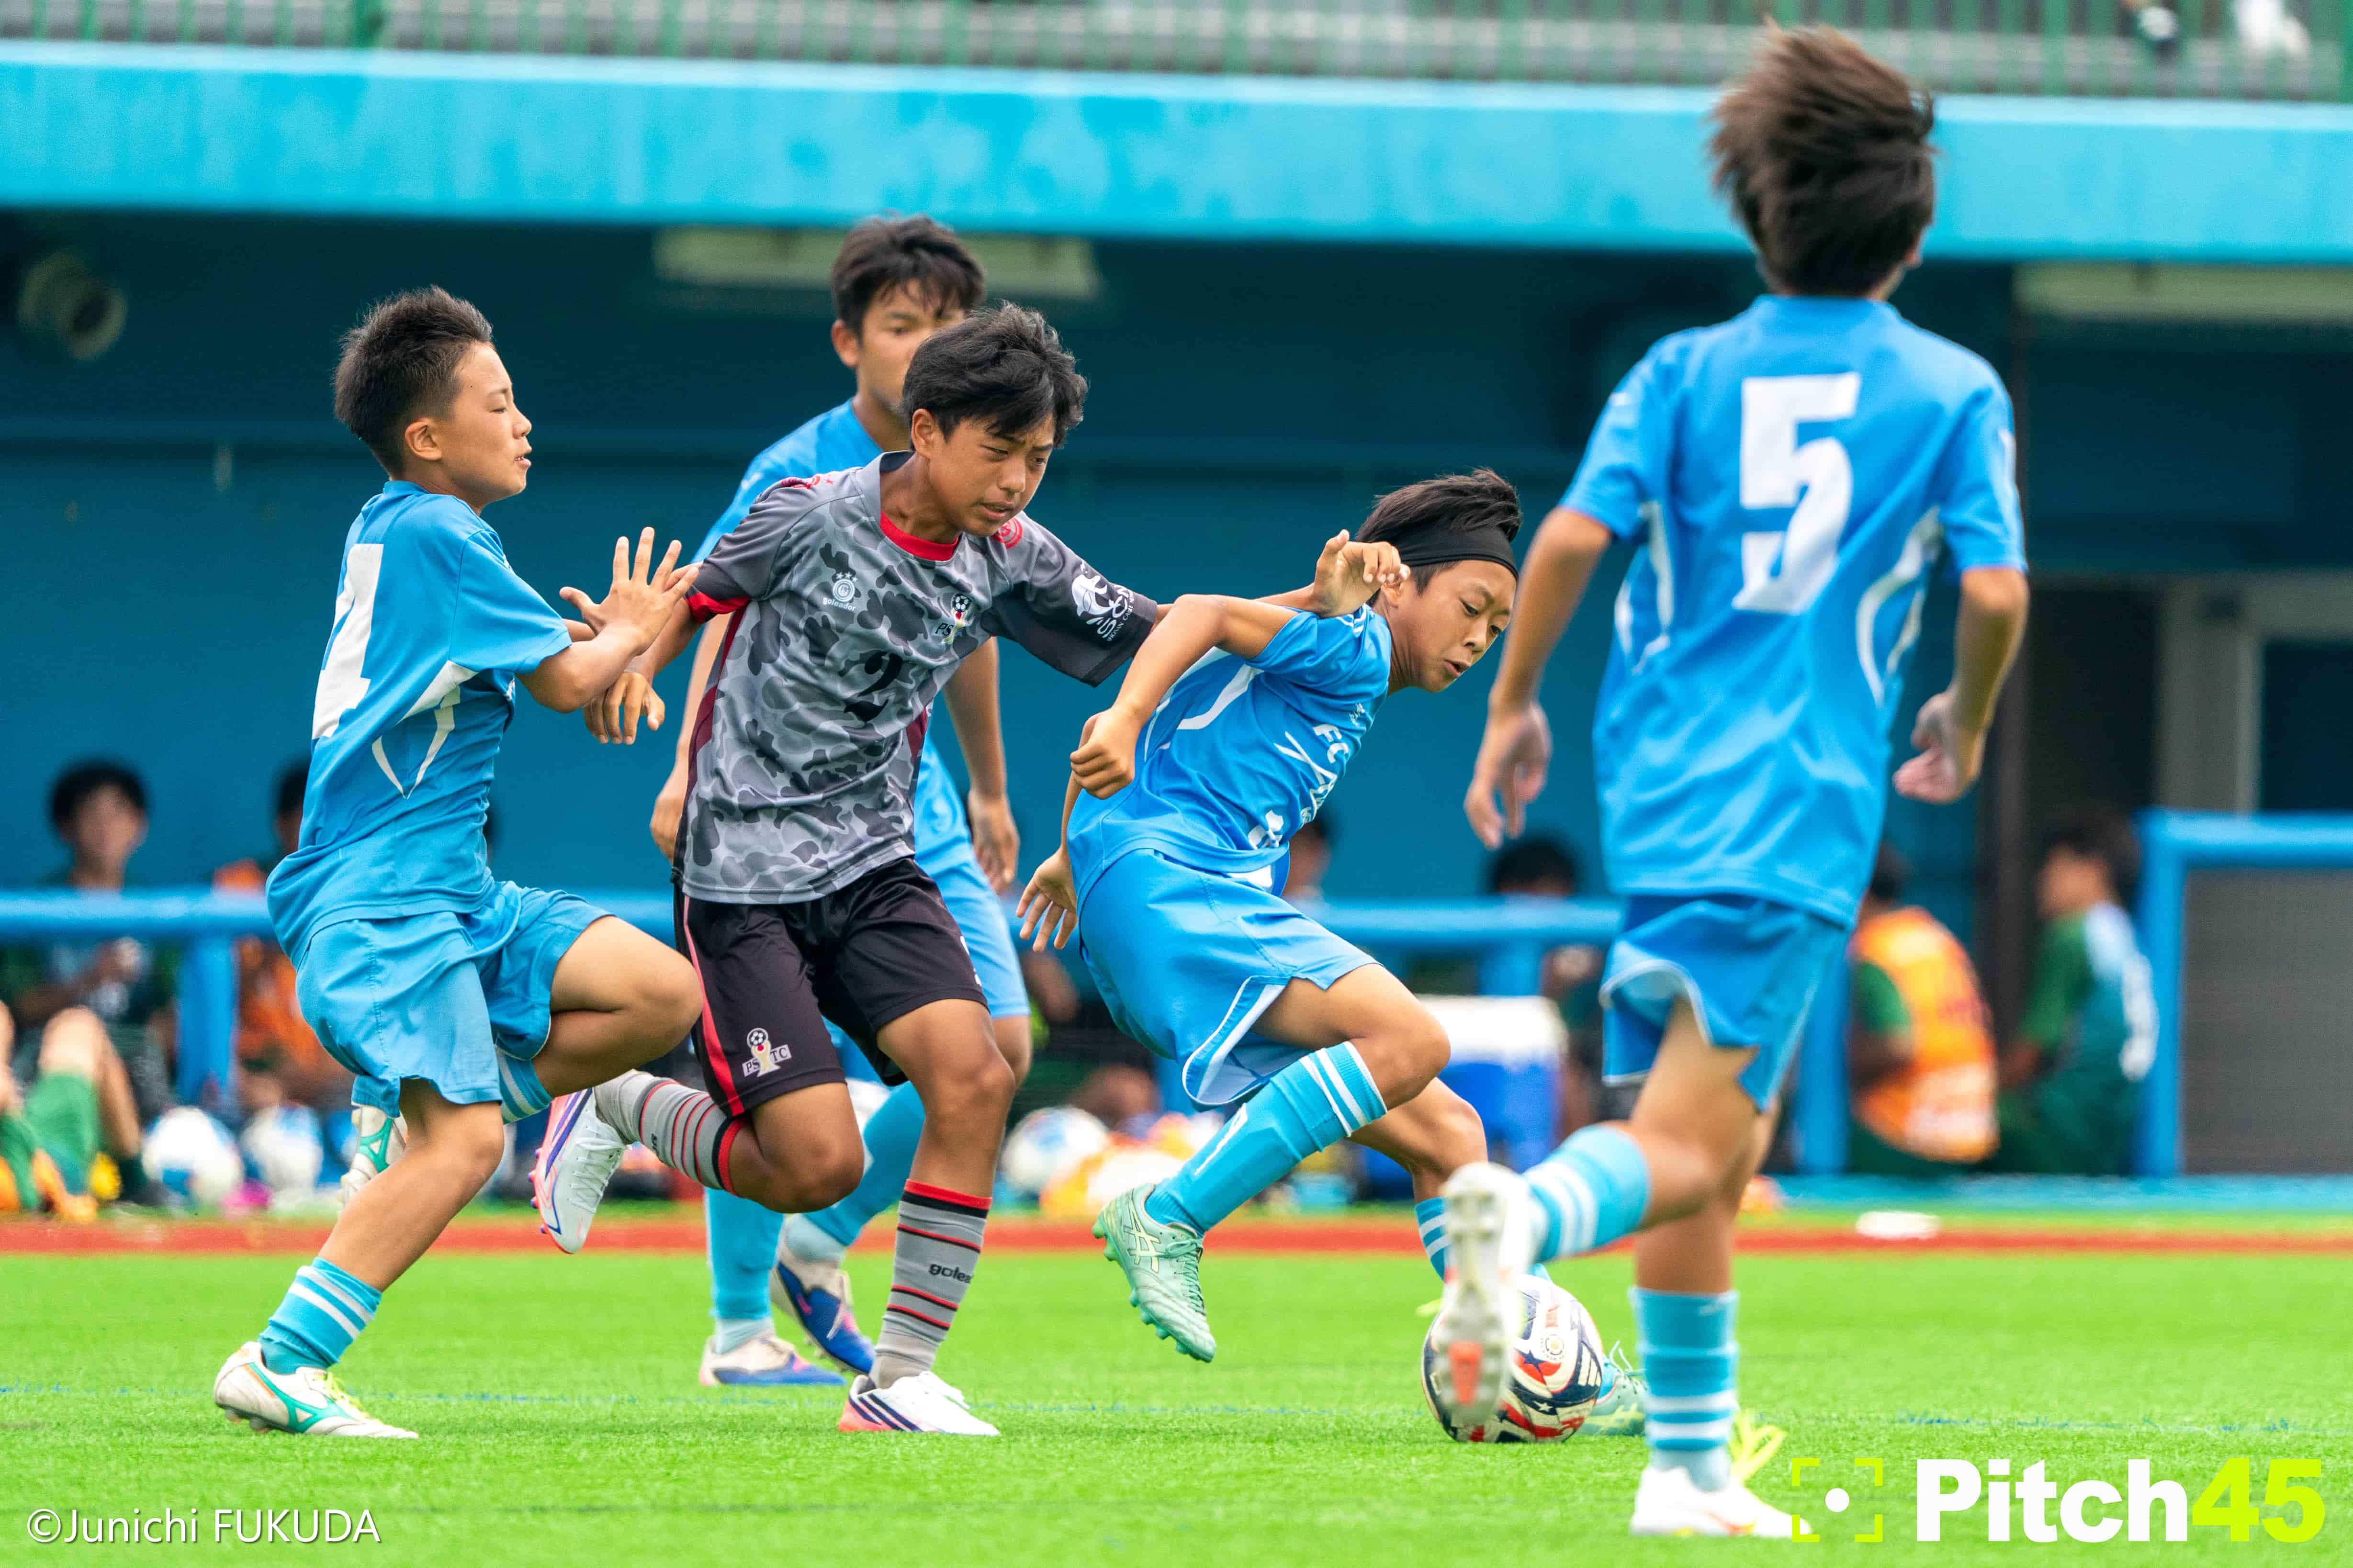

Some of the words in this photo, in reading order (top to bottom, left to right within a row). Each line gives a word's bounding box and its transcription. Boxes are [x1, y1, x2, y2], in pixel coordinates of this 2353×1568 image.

[1731, 371, 1861, 616] 5
[822, 597, 856, 611] goleador
[843, 650, 903, 722] 2
[1312, 723, 1349, 764] FC
[929, 1264, 974, 1284] golea
